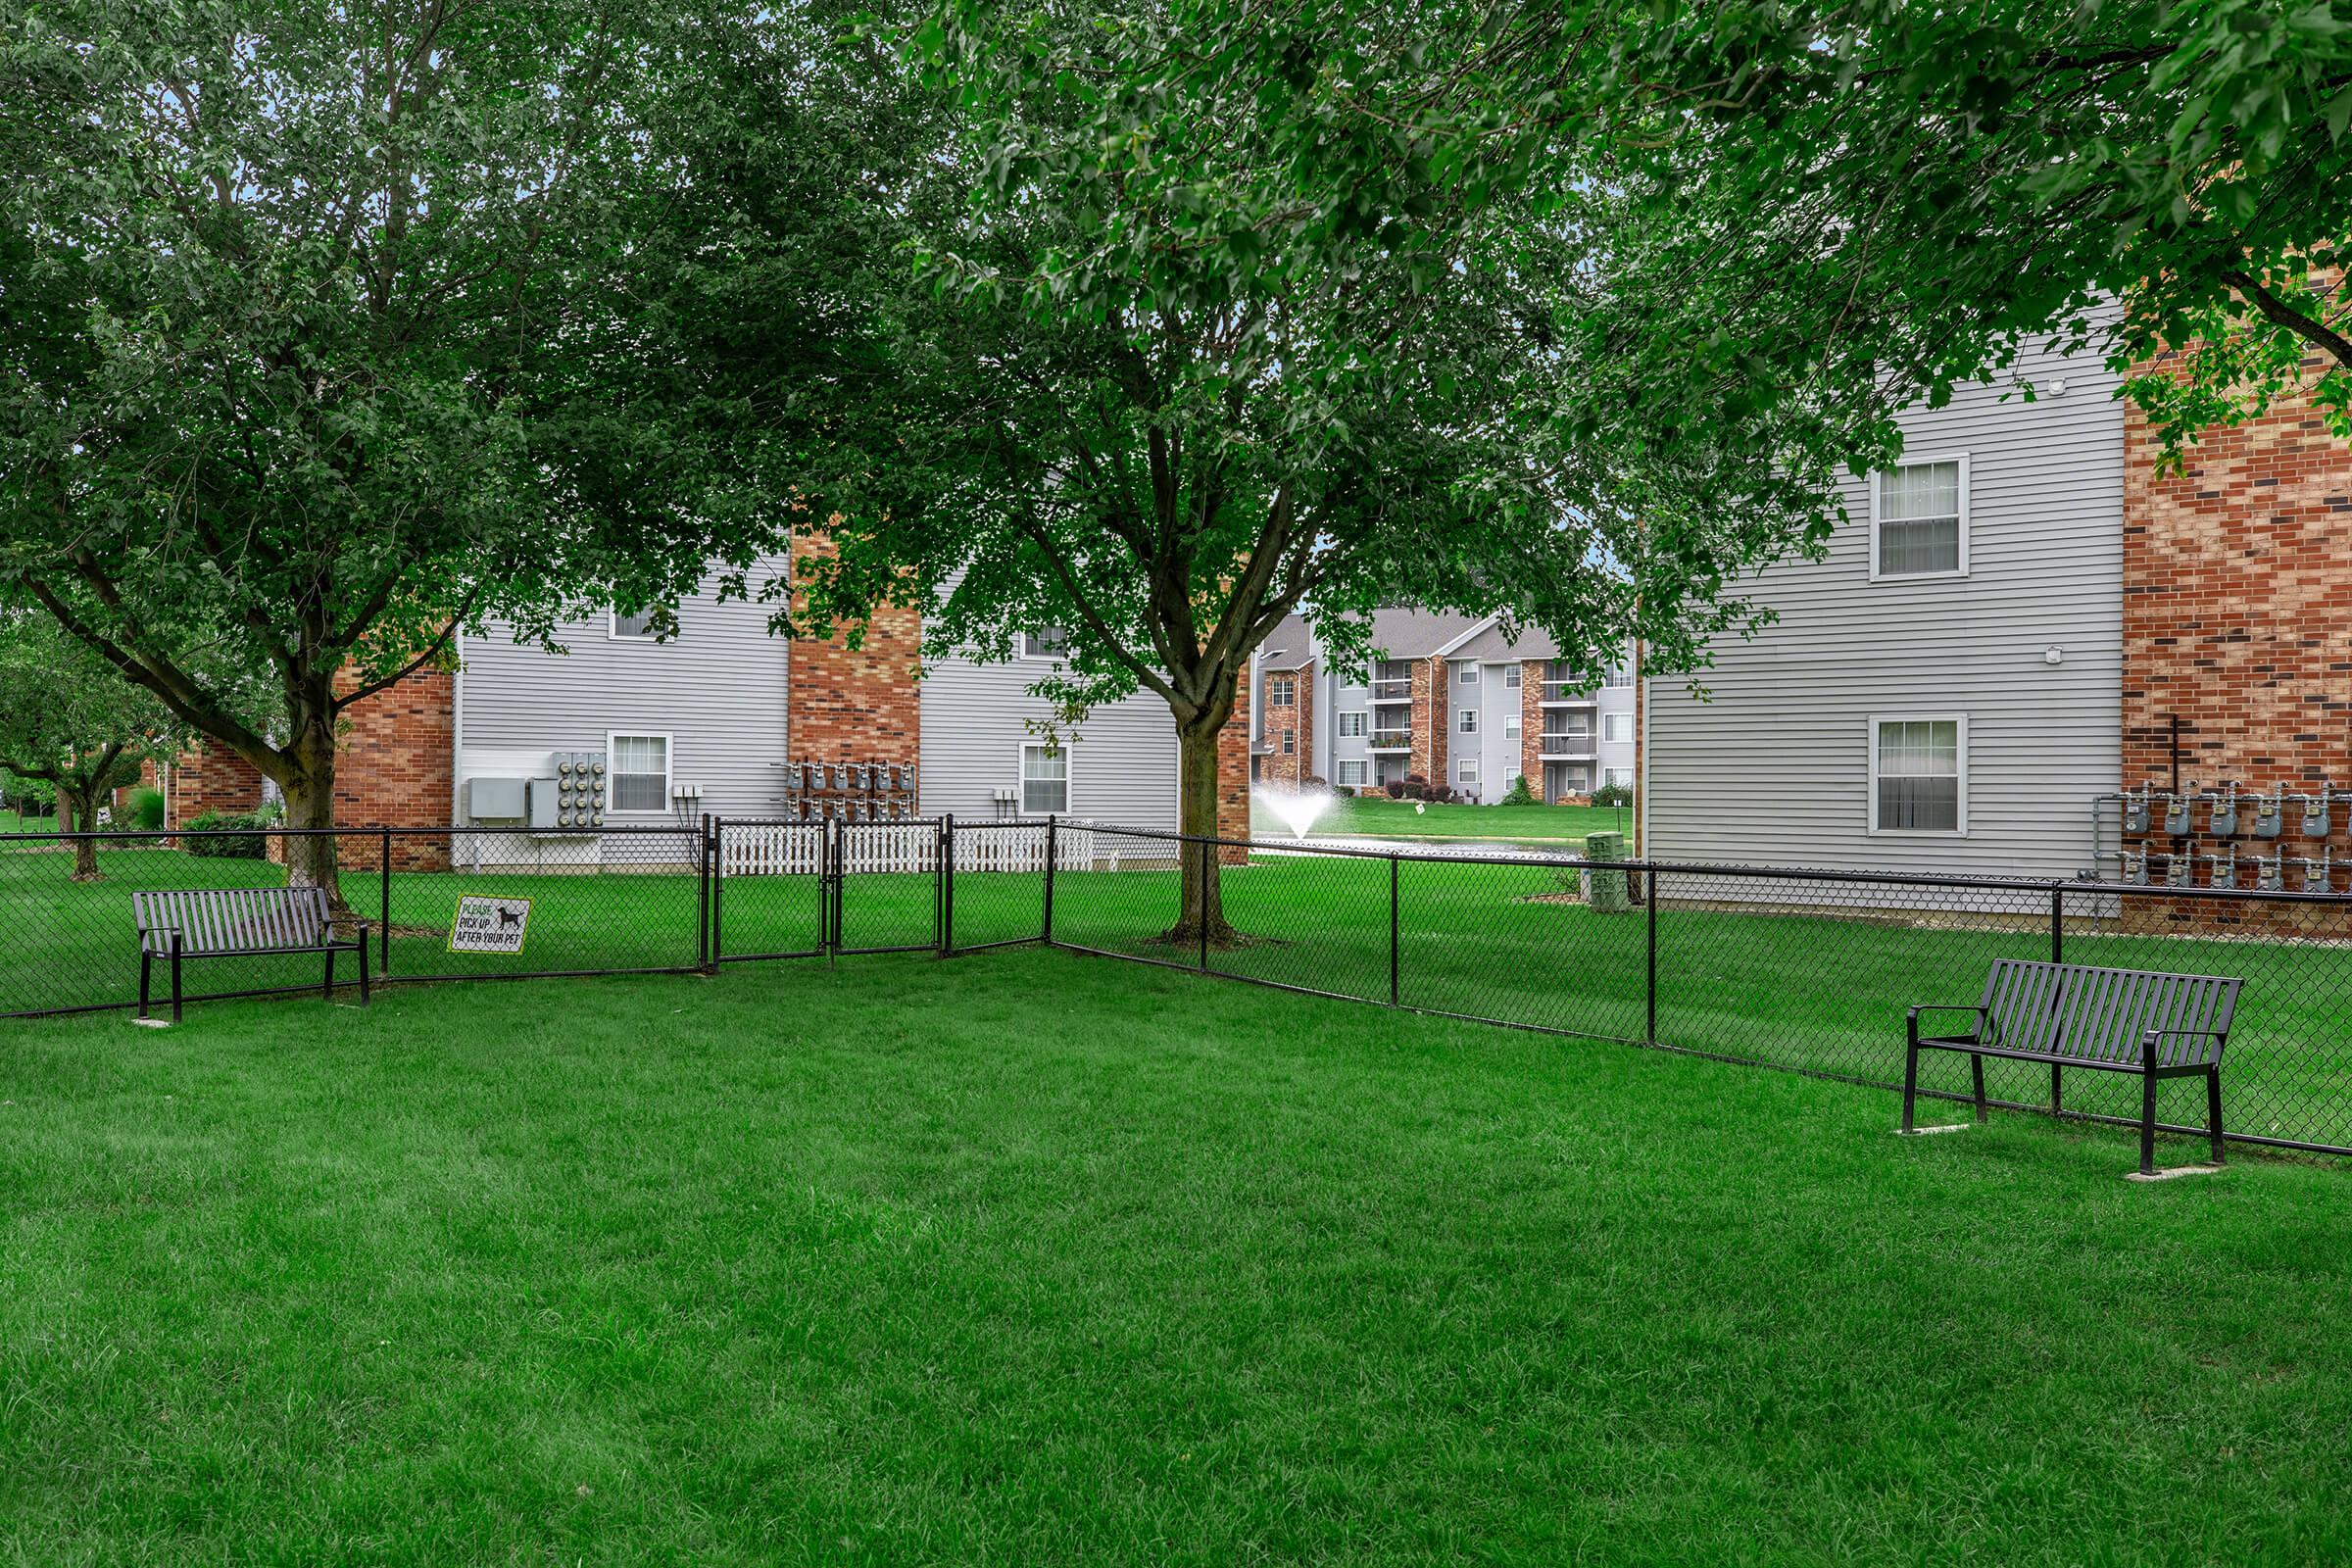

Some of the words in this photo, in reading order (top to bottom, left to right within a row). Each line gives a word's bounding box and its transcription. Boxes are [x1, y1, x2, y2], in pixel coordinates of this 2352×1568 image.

[463, 904, 493, 915] PLEASE
[459, 917, 477, 928] PICK
[479, 918, 490, 929] UP
[456, 931, 481, 943] AFTER
[483, 932, 504, 944] YOUR
[505, 934, 519, 945] PET
